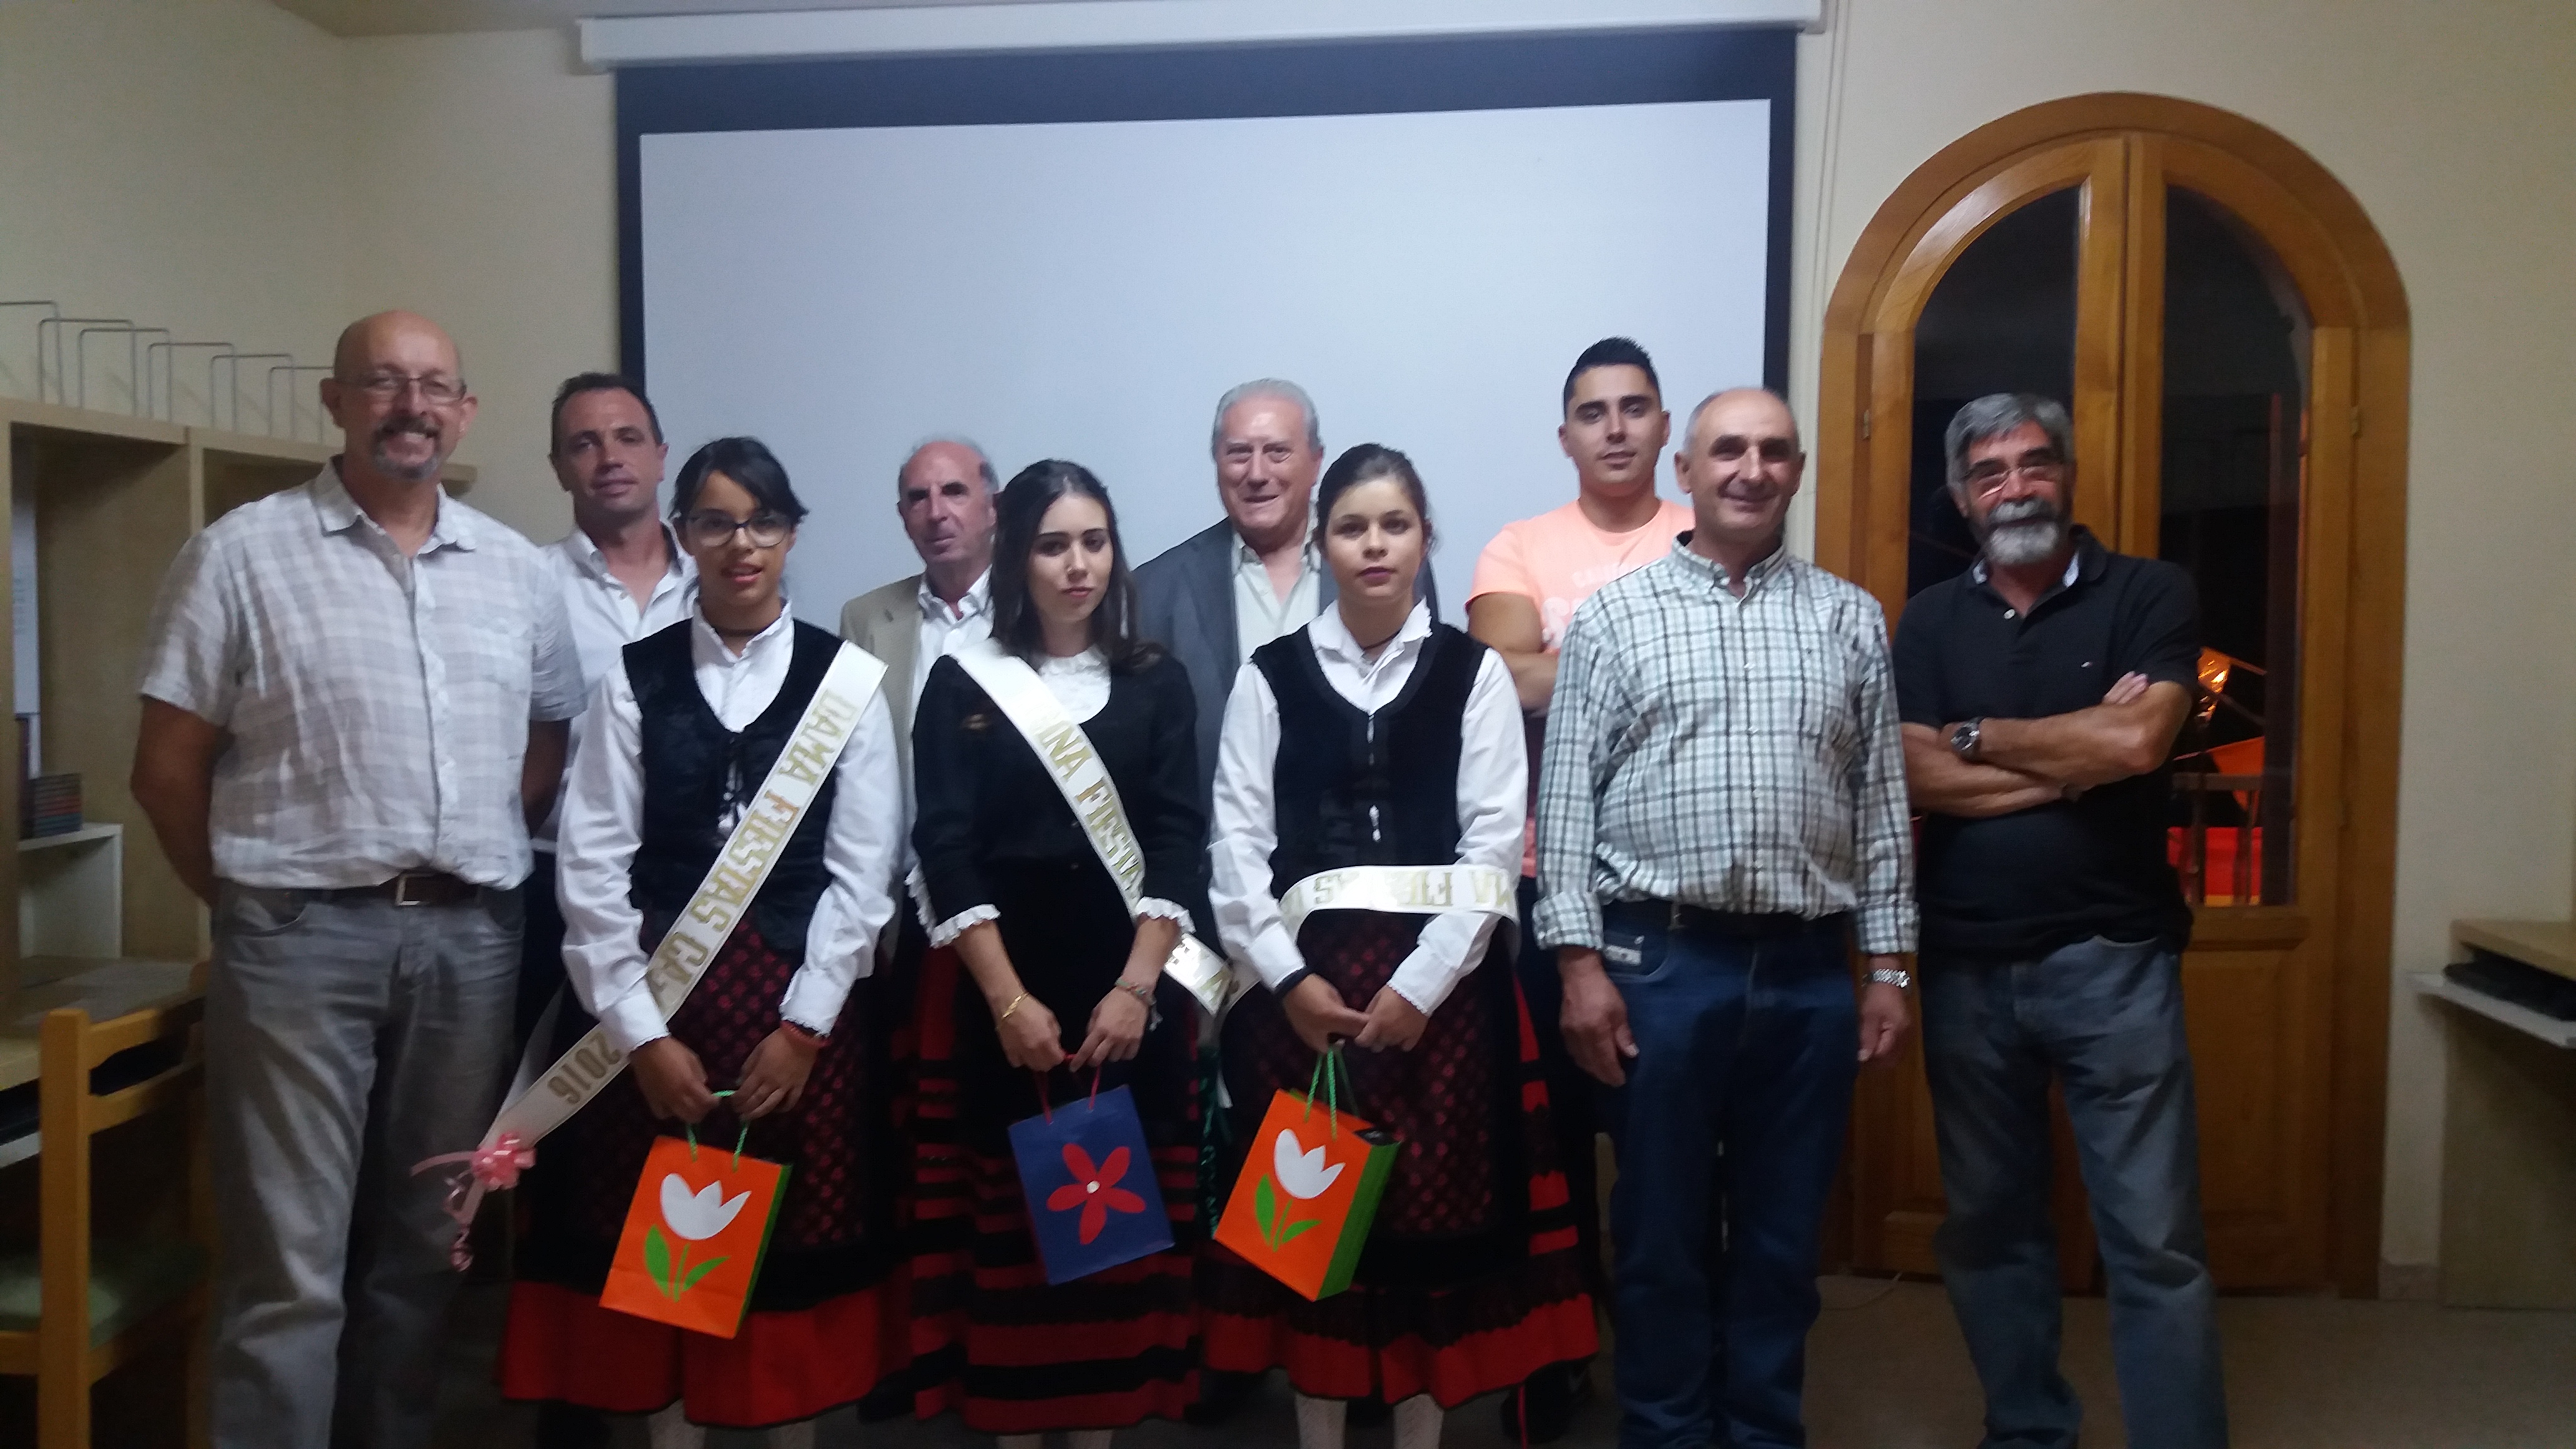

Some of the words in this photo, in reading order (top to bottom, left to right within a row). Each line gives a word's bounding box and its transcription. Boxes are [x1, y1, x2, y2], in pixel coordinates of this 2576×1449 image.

[778, 688, 857, 786] DAMA
[691, 791, 799, 933] FIESTAS
[547, 1033, 620, 1104] 2016
